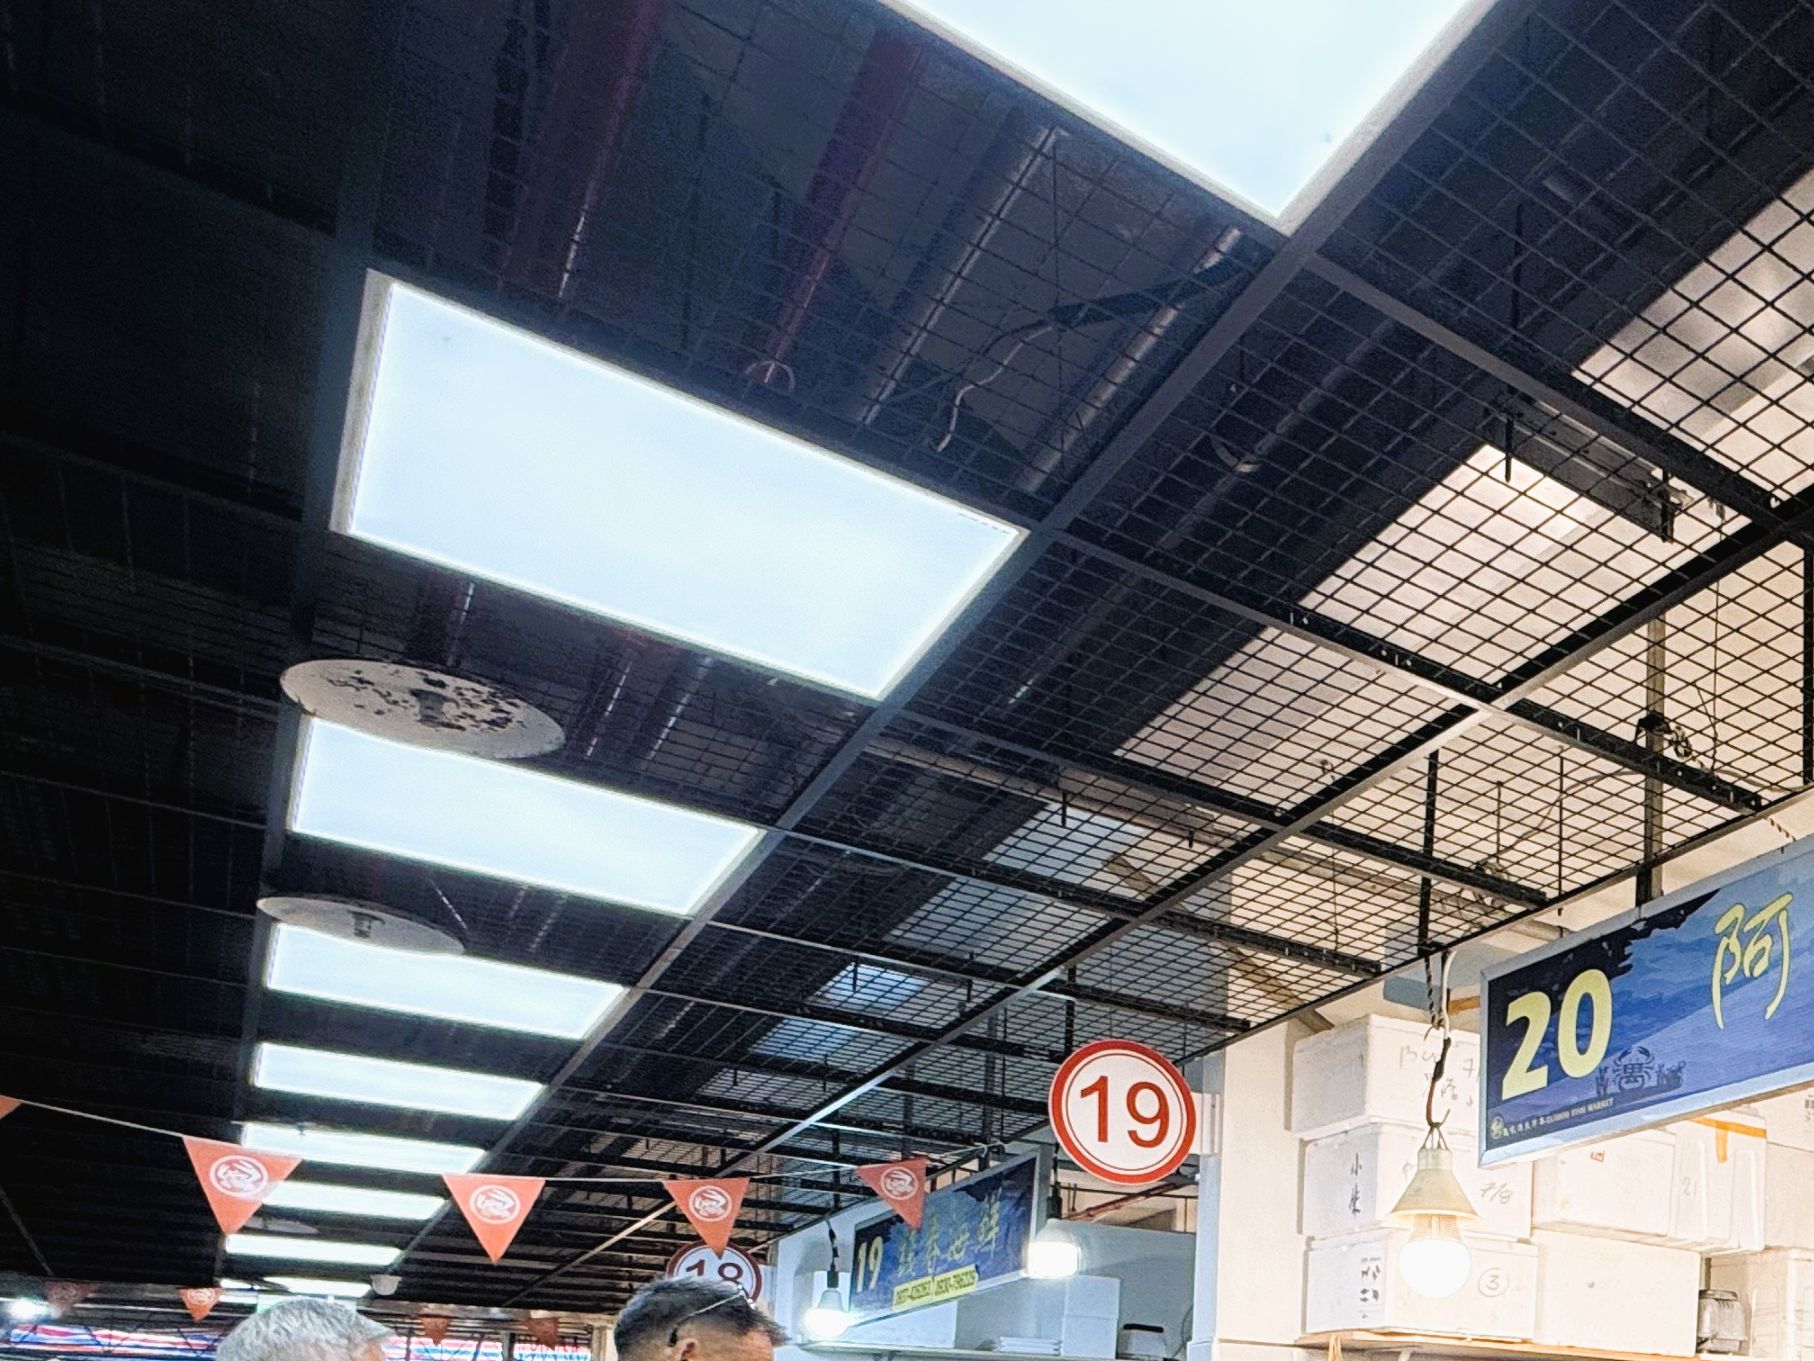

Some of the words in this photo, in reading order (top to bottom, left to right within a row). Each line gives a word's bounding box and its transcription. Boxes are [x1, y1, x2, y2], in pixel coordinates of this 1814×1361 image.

[1500, 966, 1612, 1101] 20
[1079, 1074, 1170, 1148] 19
[1587, 1097, 1614, 1113] MARKET
[857, 1235, 883, 1293] 19
